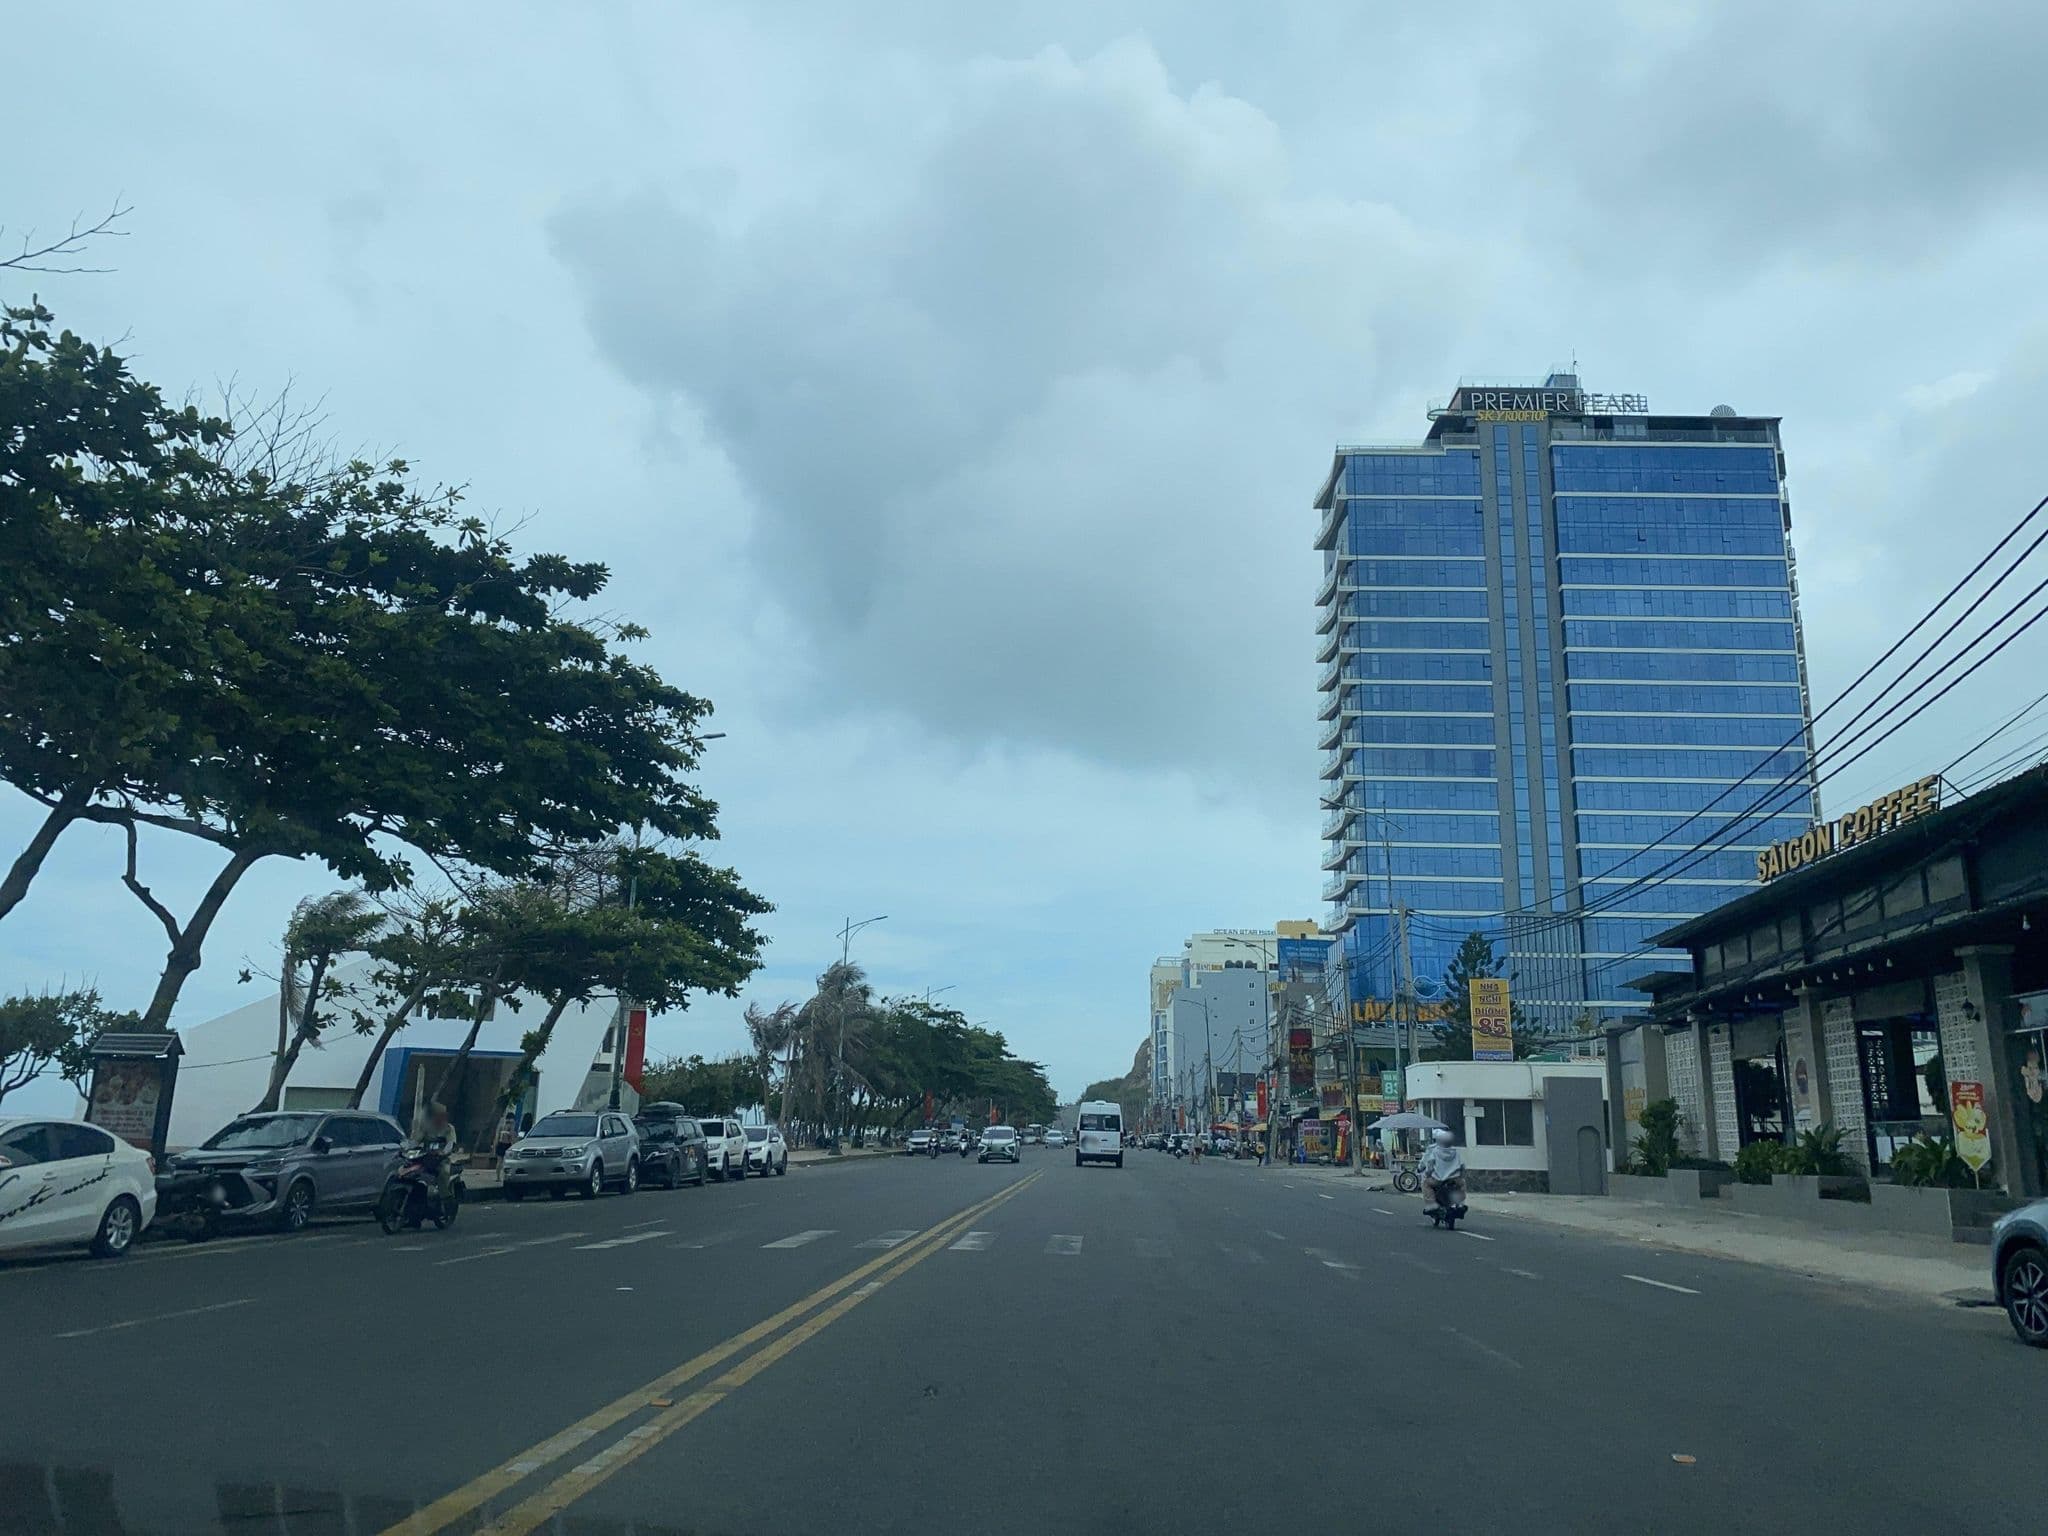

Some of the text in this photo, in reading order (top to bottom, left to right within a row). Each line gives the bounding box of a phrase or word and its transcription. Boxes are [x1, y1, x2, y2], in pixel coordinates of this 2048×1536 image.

[1471, 392, 1649, 413] PREMIER PEARL
[1757, 774, 1938, 883] SAIGON COFFEE
[1478, 1017, 1507, 1037] 85
